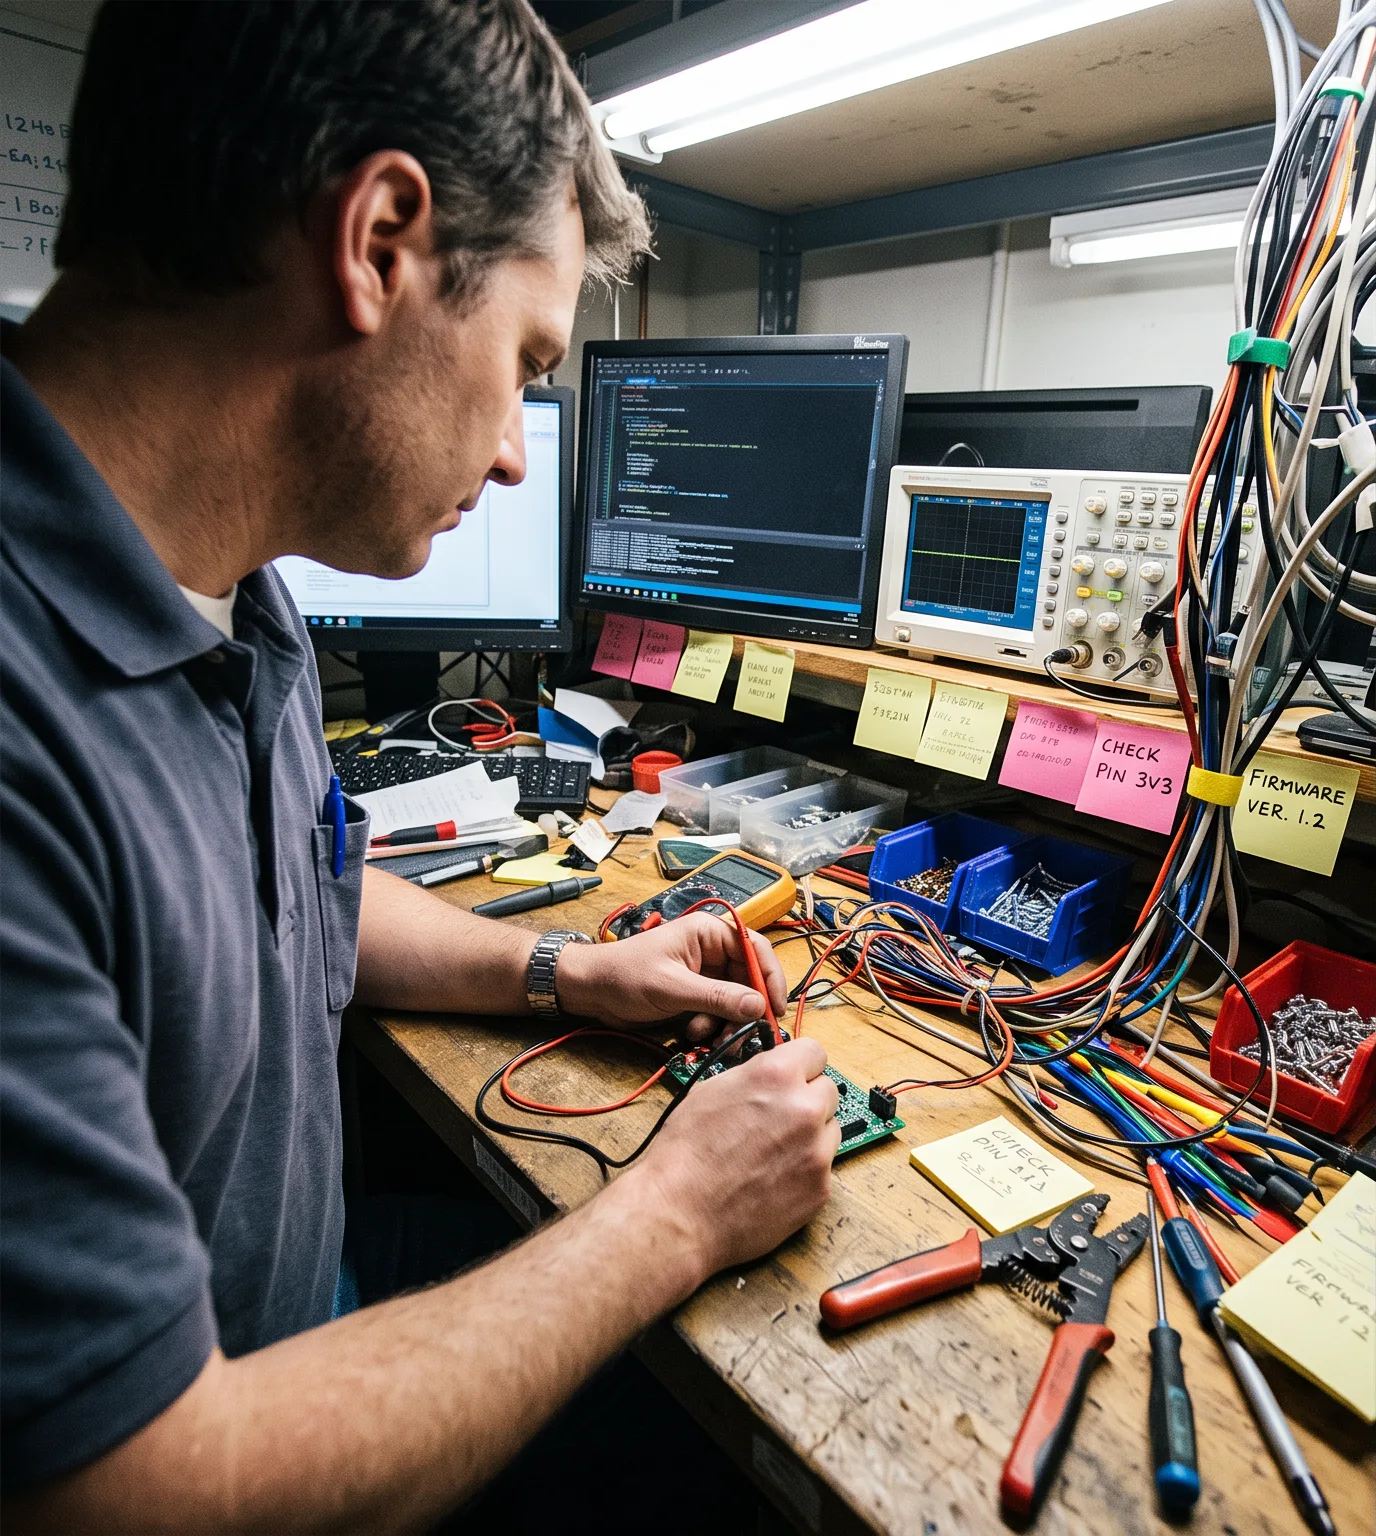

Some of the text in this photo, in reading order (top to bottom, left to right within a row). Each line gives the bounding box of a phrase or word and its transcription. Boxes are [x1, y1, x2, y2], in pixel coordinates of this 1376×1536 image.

[1102, 738, 1161, 763] CHECK
[1096, 762, 1126, 783] PIN
[1249, 768, 1346, 806] FIRMWARE
[1248, 798, 1326, 830] VER. 1.2
